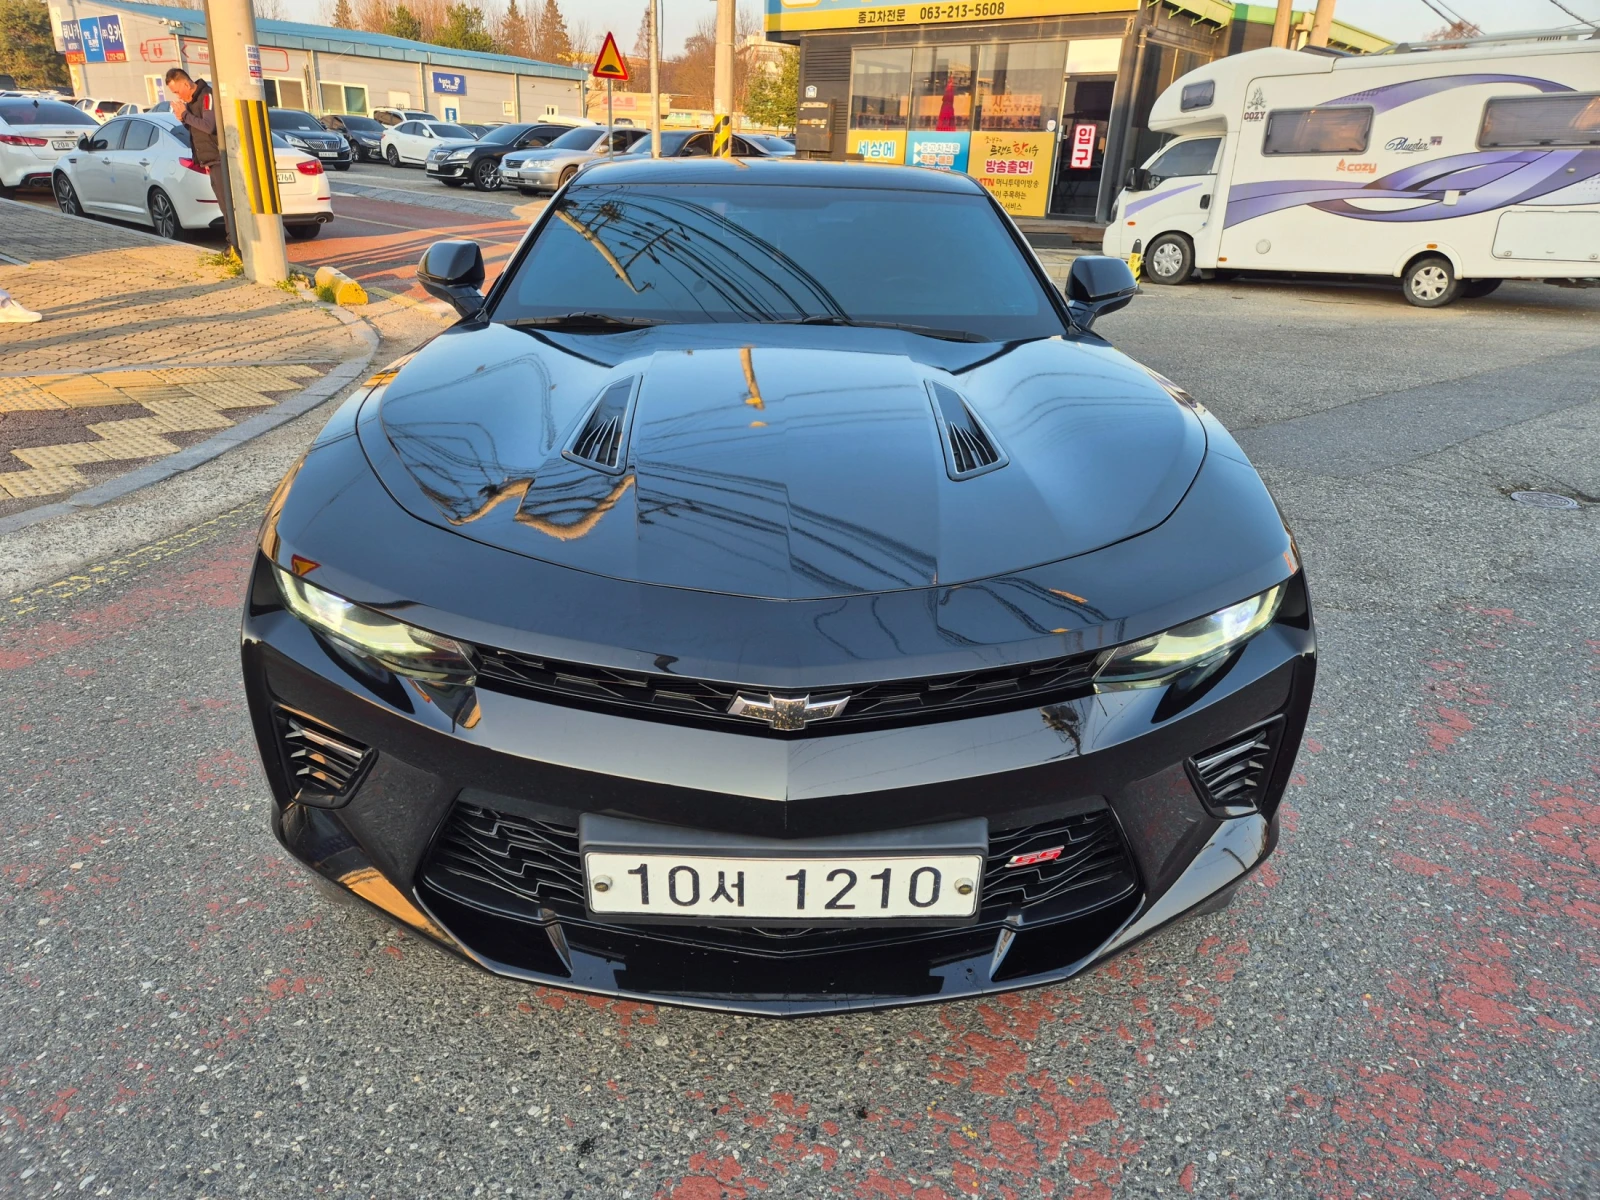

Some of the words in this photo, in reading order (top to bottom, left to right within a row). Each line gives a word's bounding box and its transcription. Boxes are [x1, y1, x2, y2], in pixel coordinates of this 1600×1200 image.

[858, 9, 906, 24] 중고차전문
[919, 2, 1005, 20] 063-213-5608
[1243, 111, 1266, 120] COZY
[858, 140, 896, 158] 세상에
[1075, 127, 1092, 165] 입구
[985, 159, 1033, 174] 방송출연!
[1346, 163, 1377, 174] cozy
[996, 178, 1040, 188] 머니투데이방송
[1002, 190, 1027, 200] 주목하는
[1004, 202, 1023, 211] 서비스
[627, 863, 746, 908] 10서
[785, 866, 942, 911] 1210
